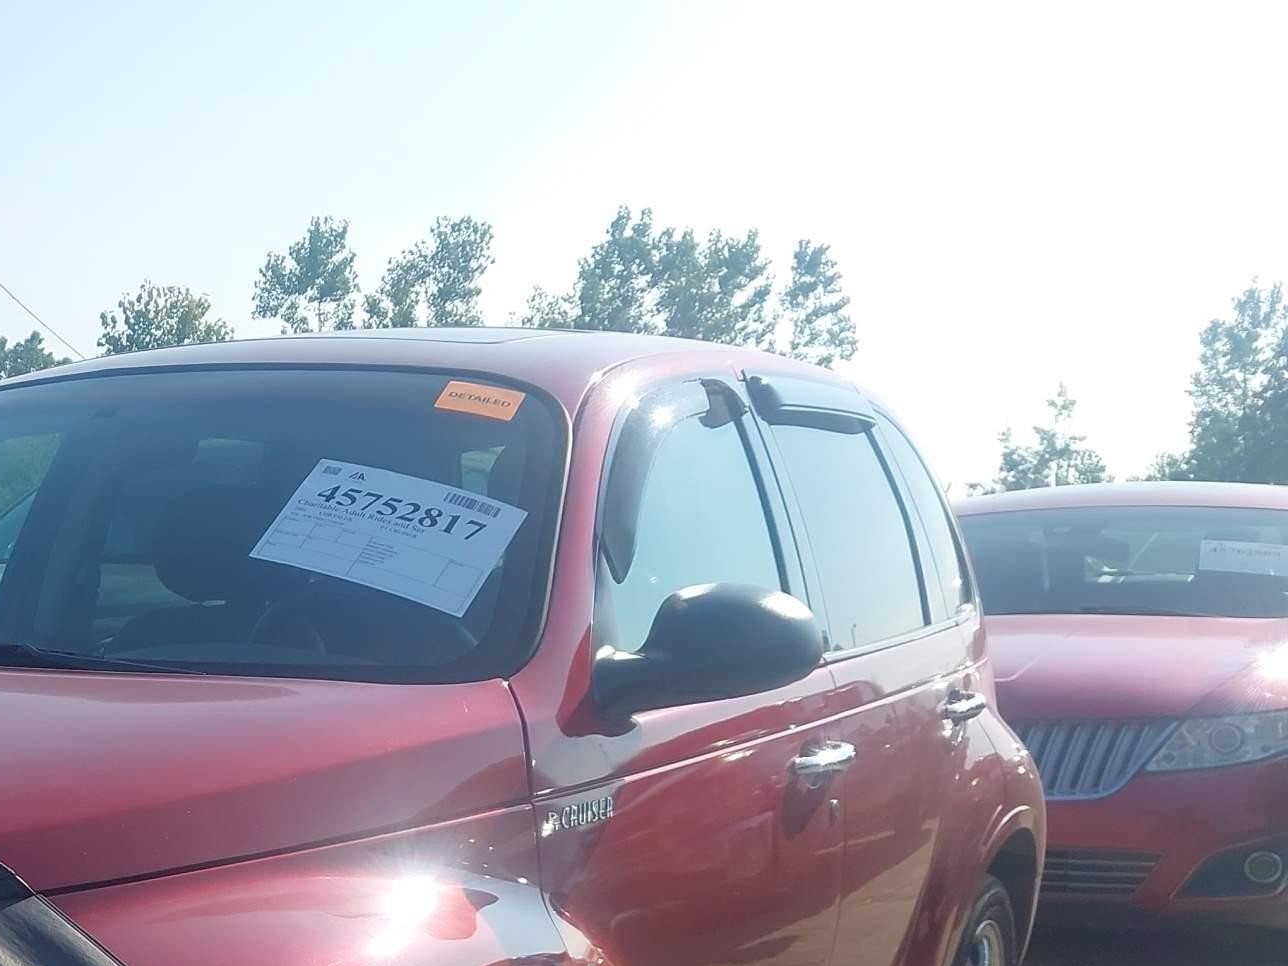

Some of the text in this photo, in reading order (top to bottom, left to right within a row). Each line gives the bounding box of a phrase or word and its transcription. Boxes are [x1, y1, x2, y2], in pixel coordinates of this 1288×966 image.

[448, 391, 512, 408] DETAILED
[316, 484, 488, 541] 45752817
[562, 797, 614, 828] CRUISER
